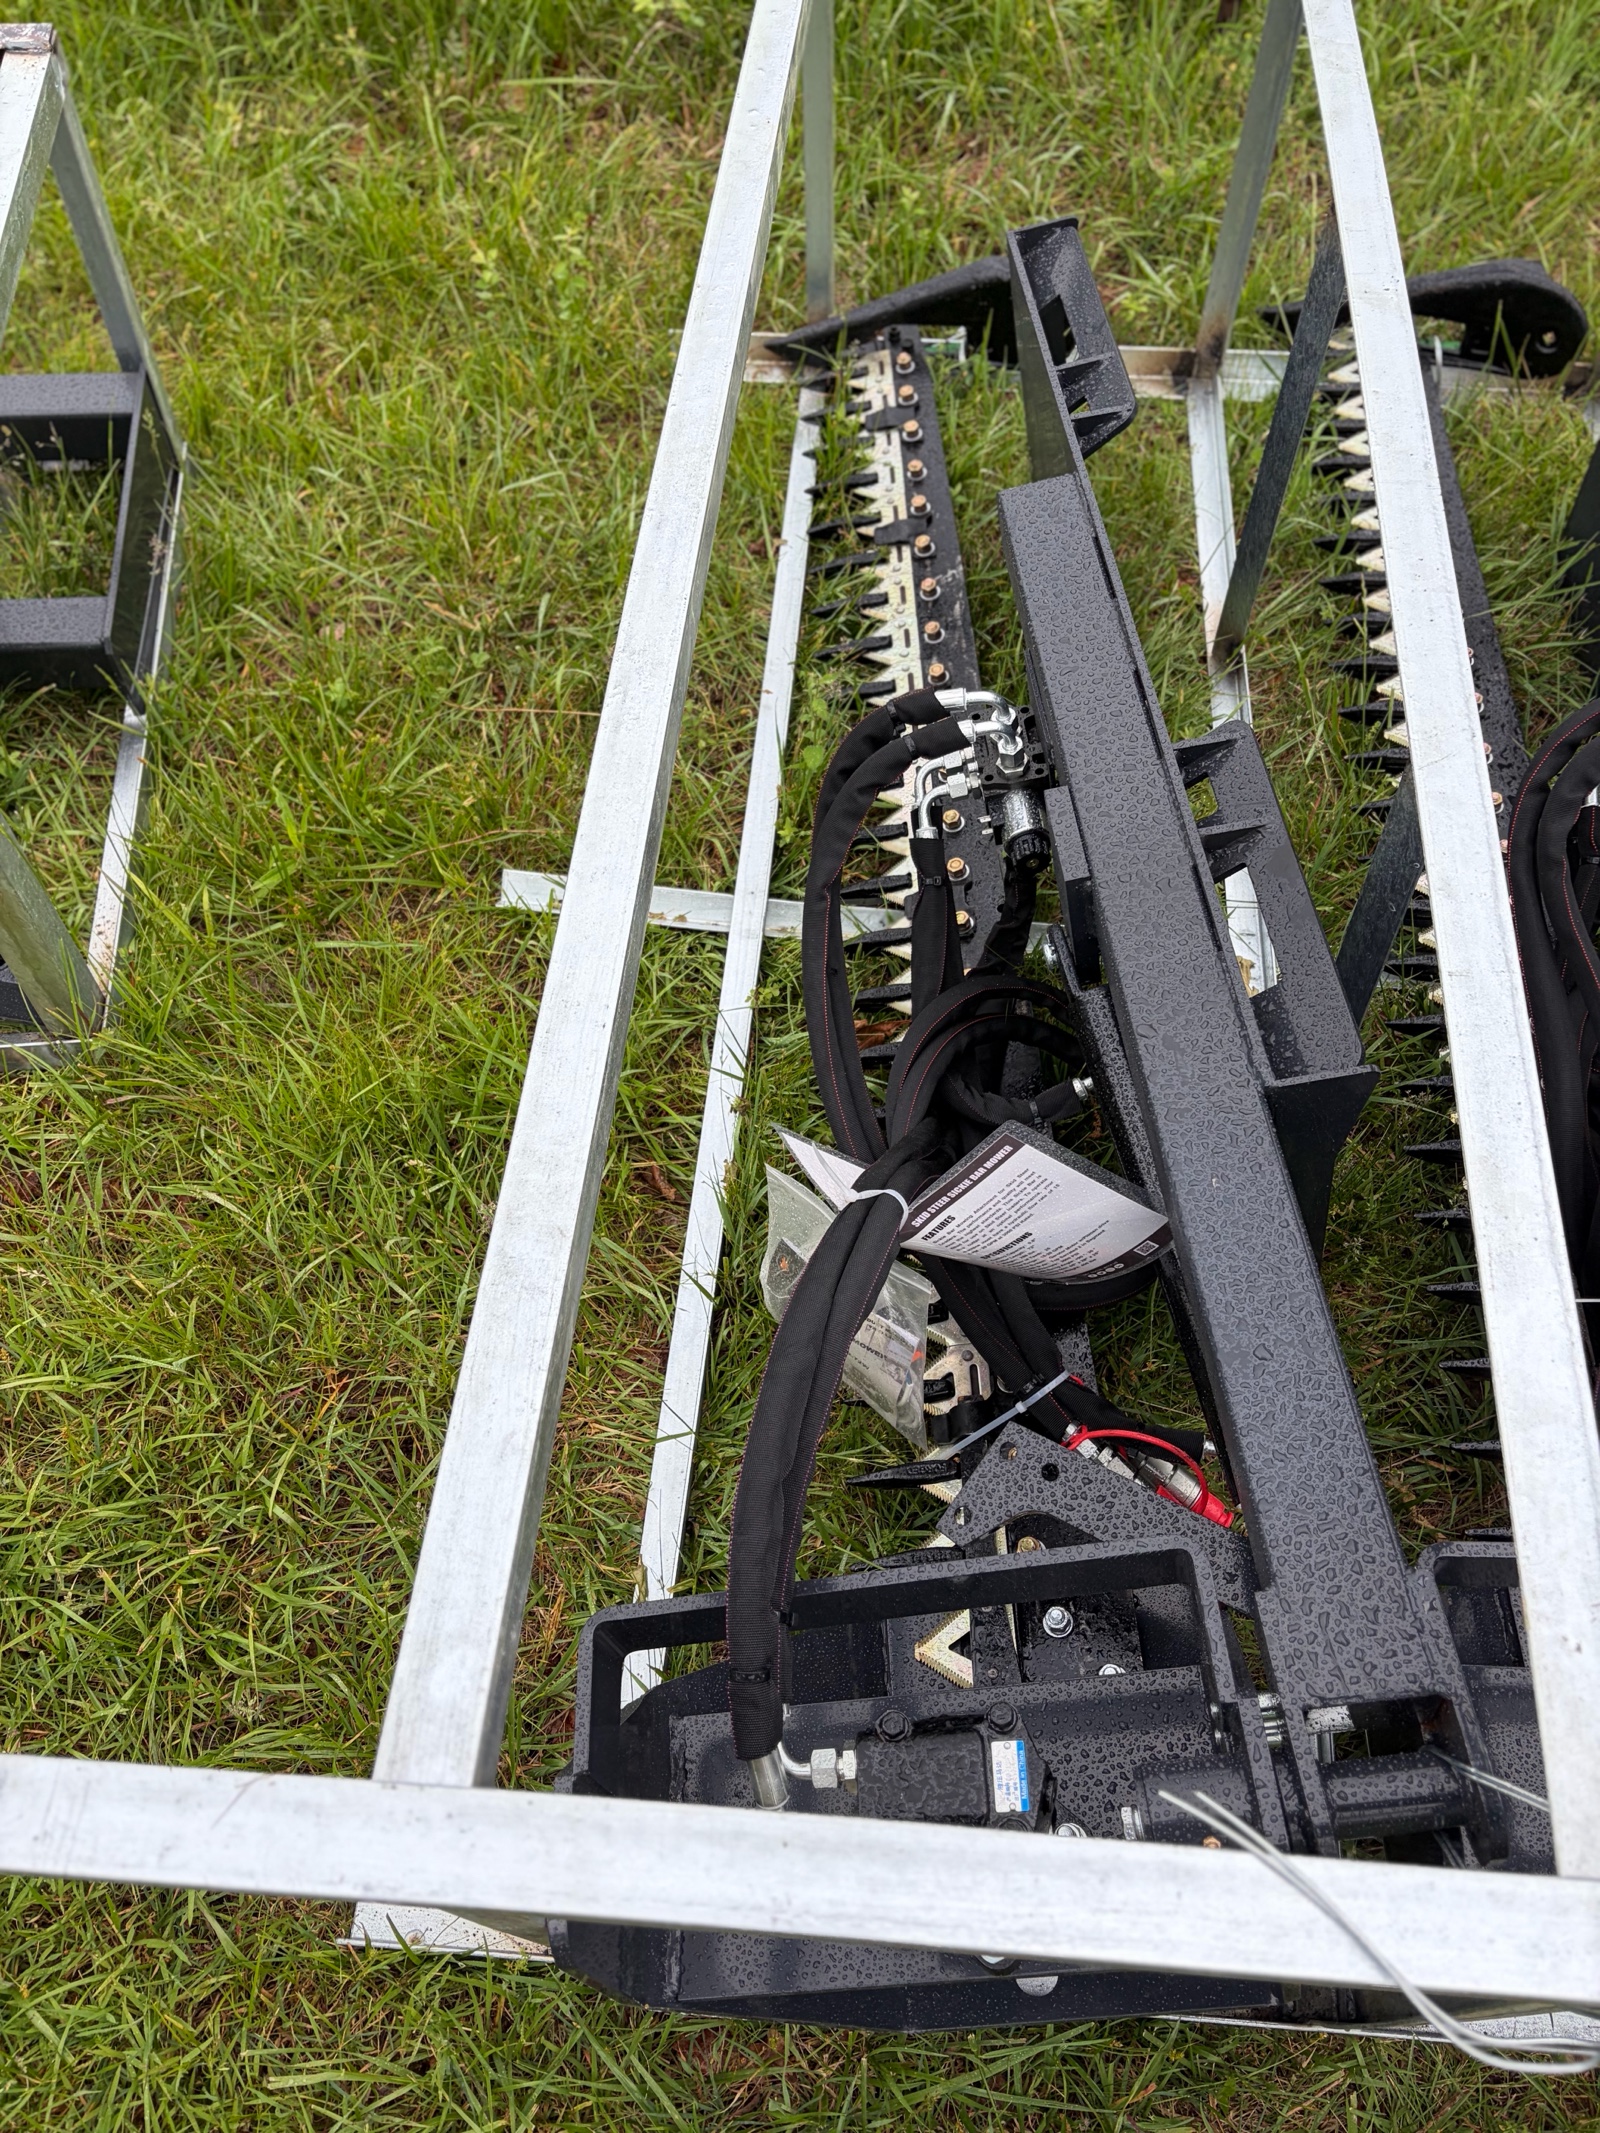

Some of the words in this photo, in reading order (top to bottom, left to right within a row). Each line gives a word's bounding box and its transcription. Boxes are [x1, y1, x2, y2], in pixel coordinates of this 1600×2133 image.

[911, 1211, 929, 1228] SKID
[927, 1196, 949, 1213] STEER
[969, 1167, 988, 1183] BAR
[983, 1144, 1014, 1170] MOWER
[921, 1215, 956, 1241] FEATURES
